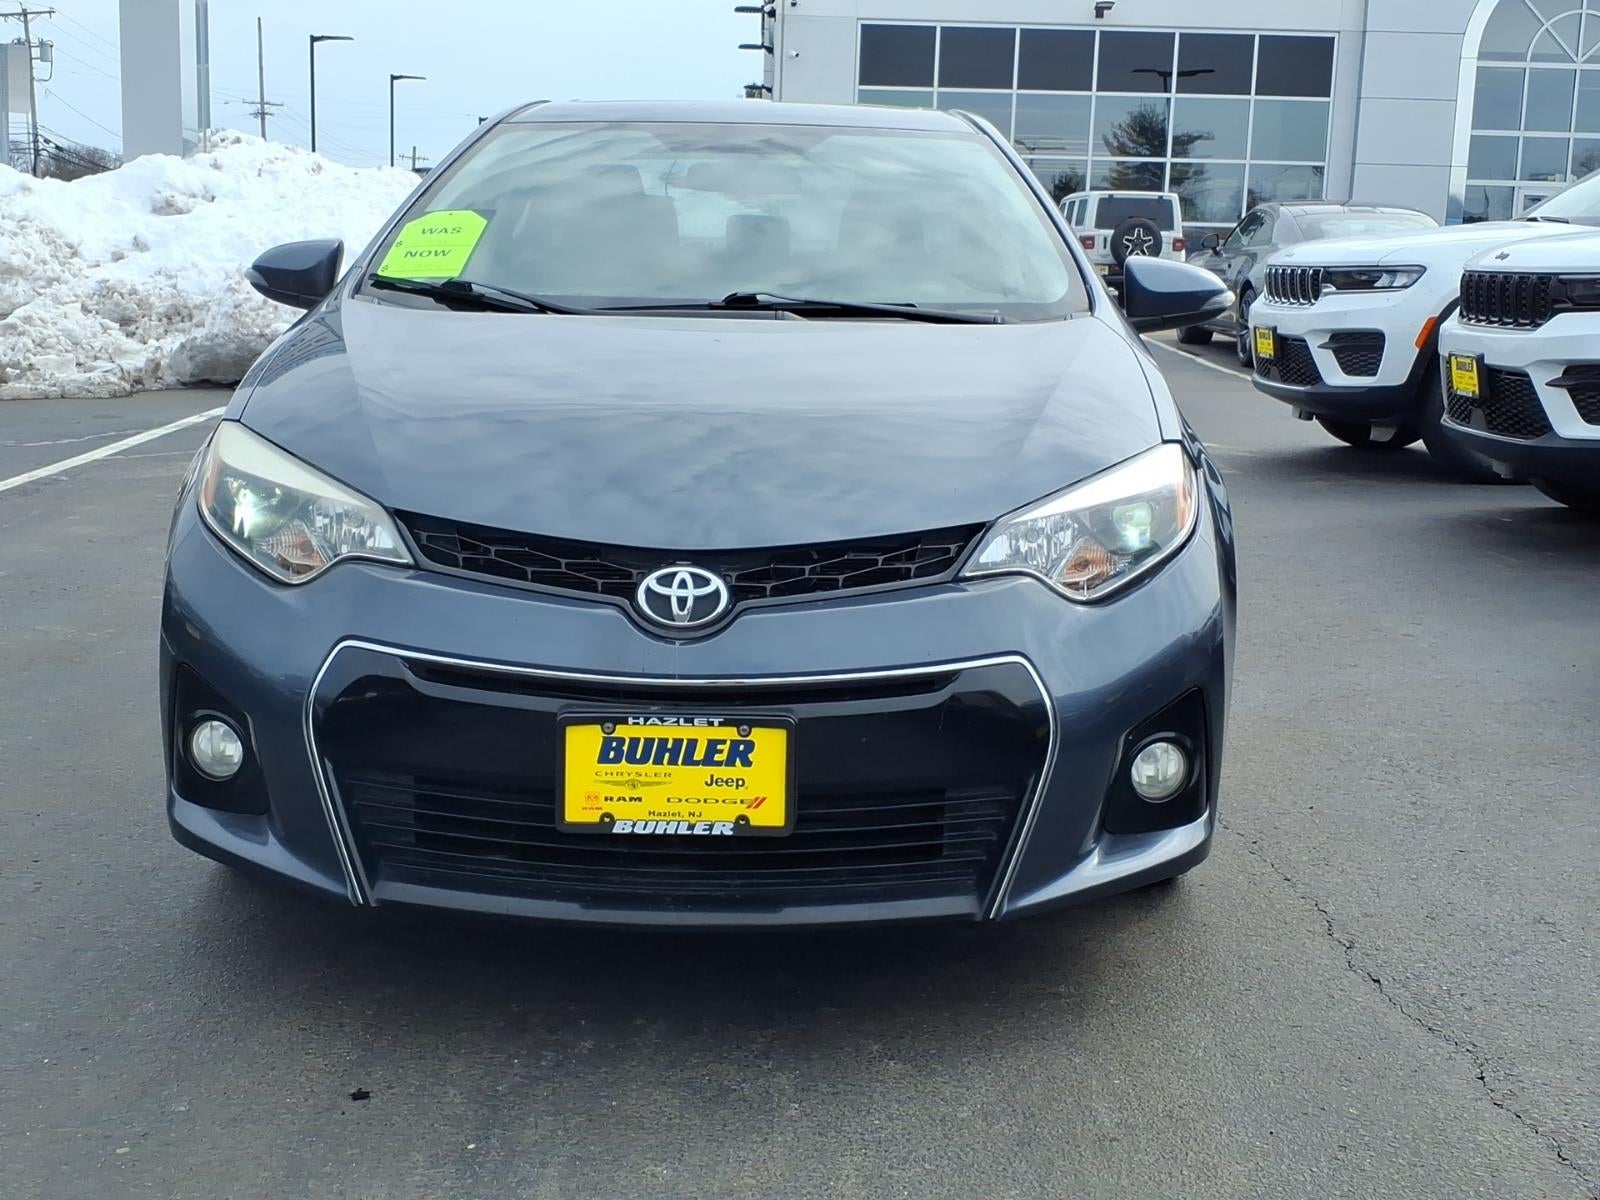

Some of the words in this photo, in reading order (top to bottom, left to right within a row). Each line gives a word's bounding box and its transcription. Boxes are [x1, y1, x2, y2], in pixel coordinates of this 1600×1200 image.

[421, 226, 463, 235] WAS
[404, 249, 452, 258] NOW
[627, 716, 725, 727] HAZLET
[597, 736, 755, 768] BUHLER
[594, 770, 673, 778] CHRYSLER
[704, 774, 746, 790] Jeep
[603, 795, 643, 803] RAM
[666, 796, 753, 805] DODGE
[648, 810, 685, 819] Hazlet,
[612, 819, 734, 836] BUHLER
